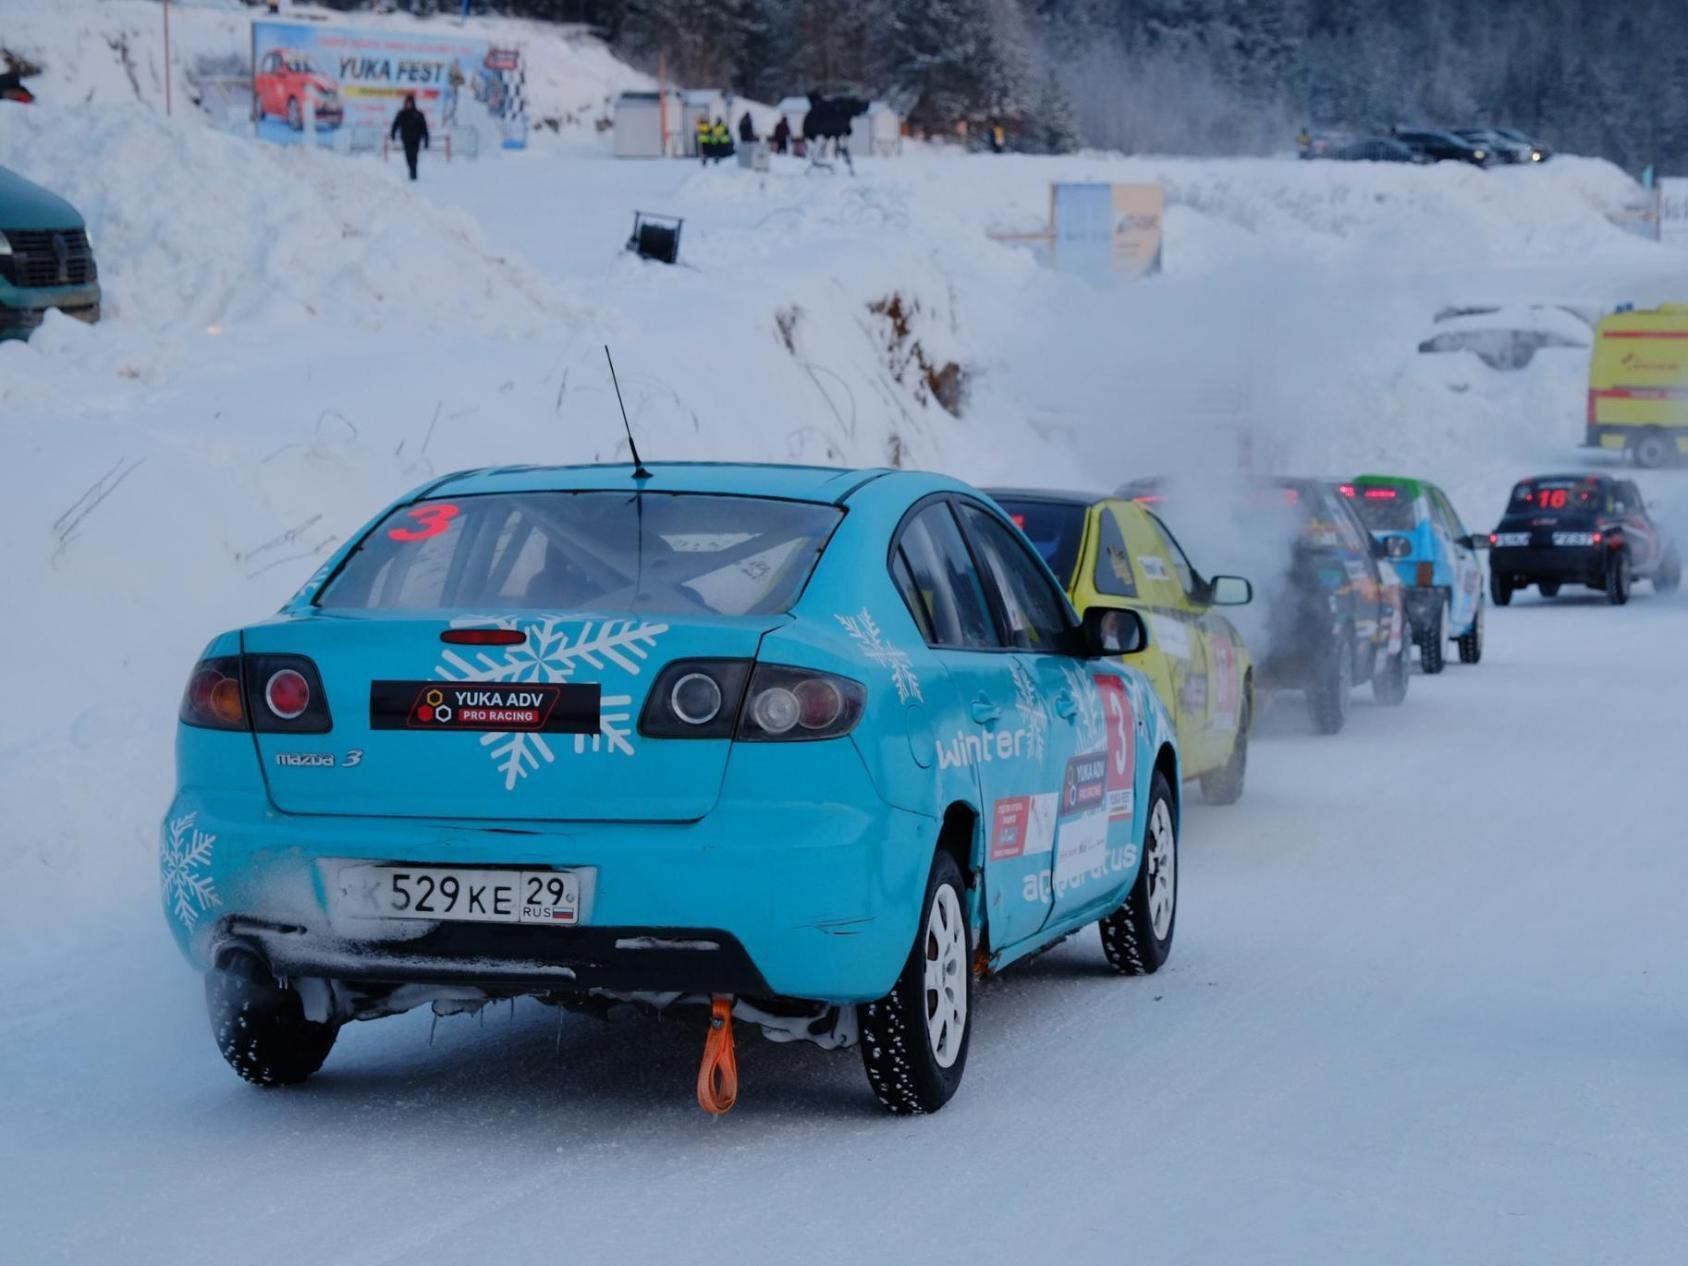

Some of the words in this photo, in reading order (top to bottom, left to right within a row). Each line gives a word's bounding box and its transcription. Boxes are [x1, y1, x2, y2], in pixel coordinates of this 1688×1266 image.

[339, 56, 391, 79] YUKA
[396, 60, 444, 82] FEST
[1538, 488, 1568, 510] 16
[388, 504, 460, 542] 3
[455, 691, 503, 706] YUKA
[506, 693, 543, 707] ADV
[463, 711, 486, 720] PRO
[489, 711, 533, 721] RACING
[1110, 691, 1127, 775] 3
[276, 753, 335, 766] mazda
[342, 749, 363, 767] 3
[936, 729, 1025, 769] winter
[526, 877, 565, 905] 29
[523, 906, 551, 918] RUS
